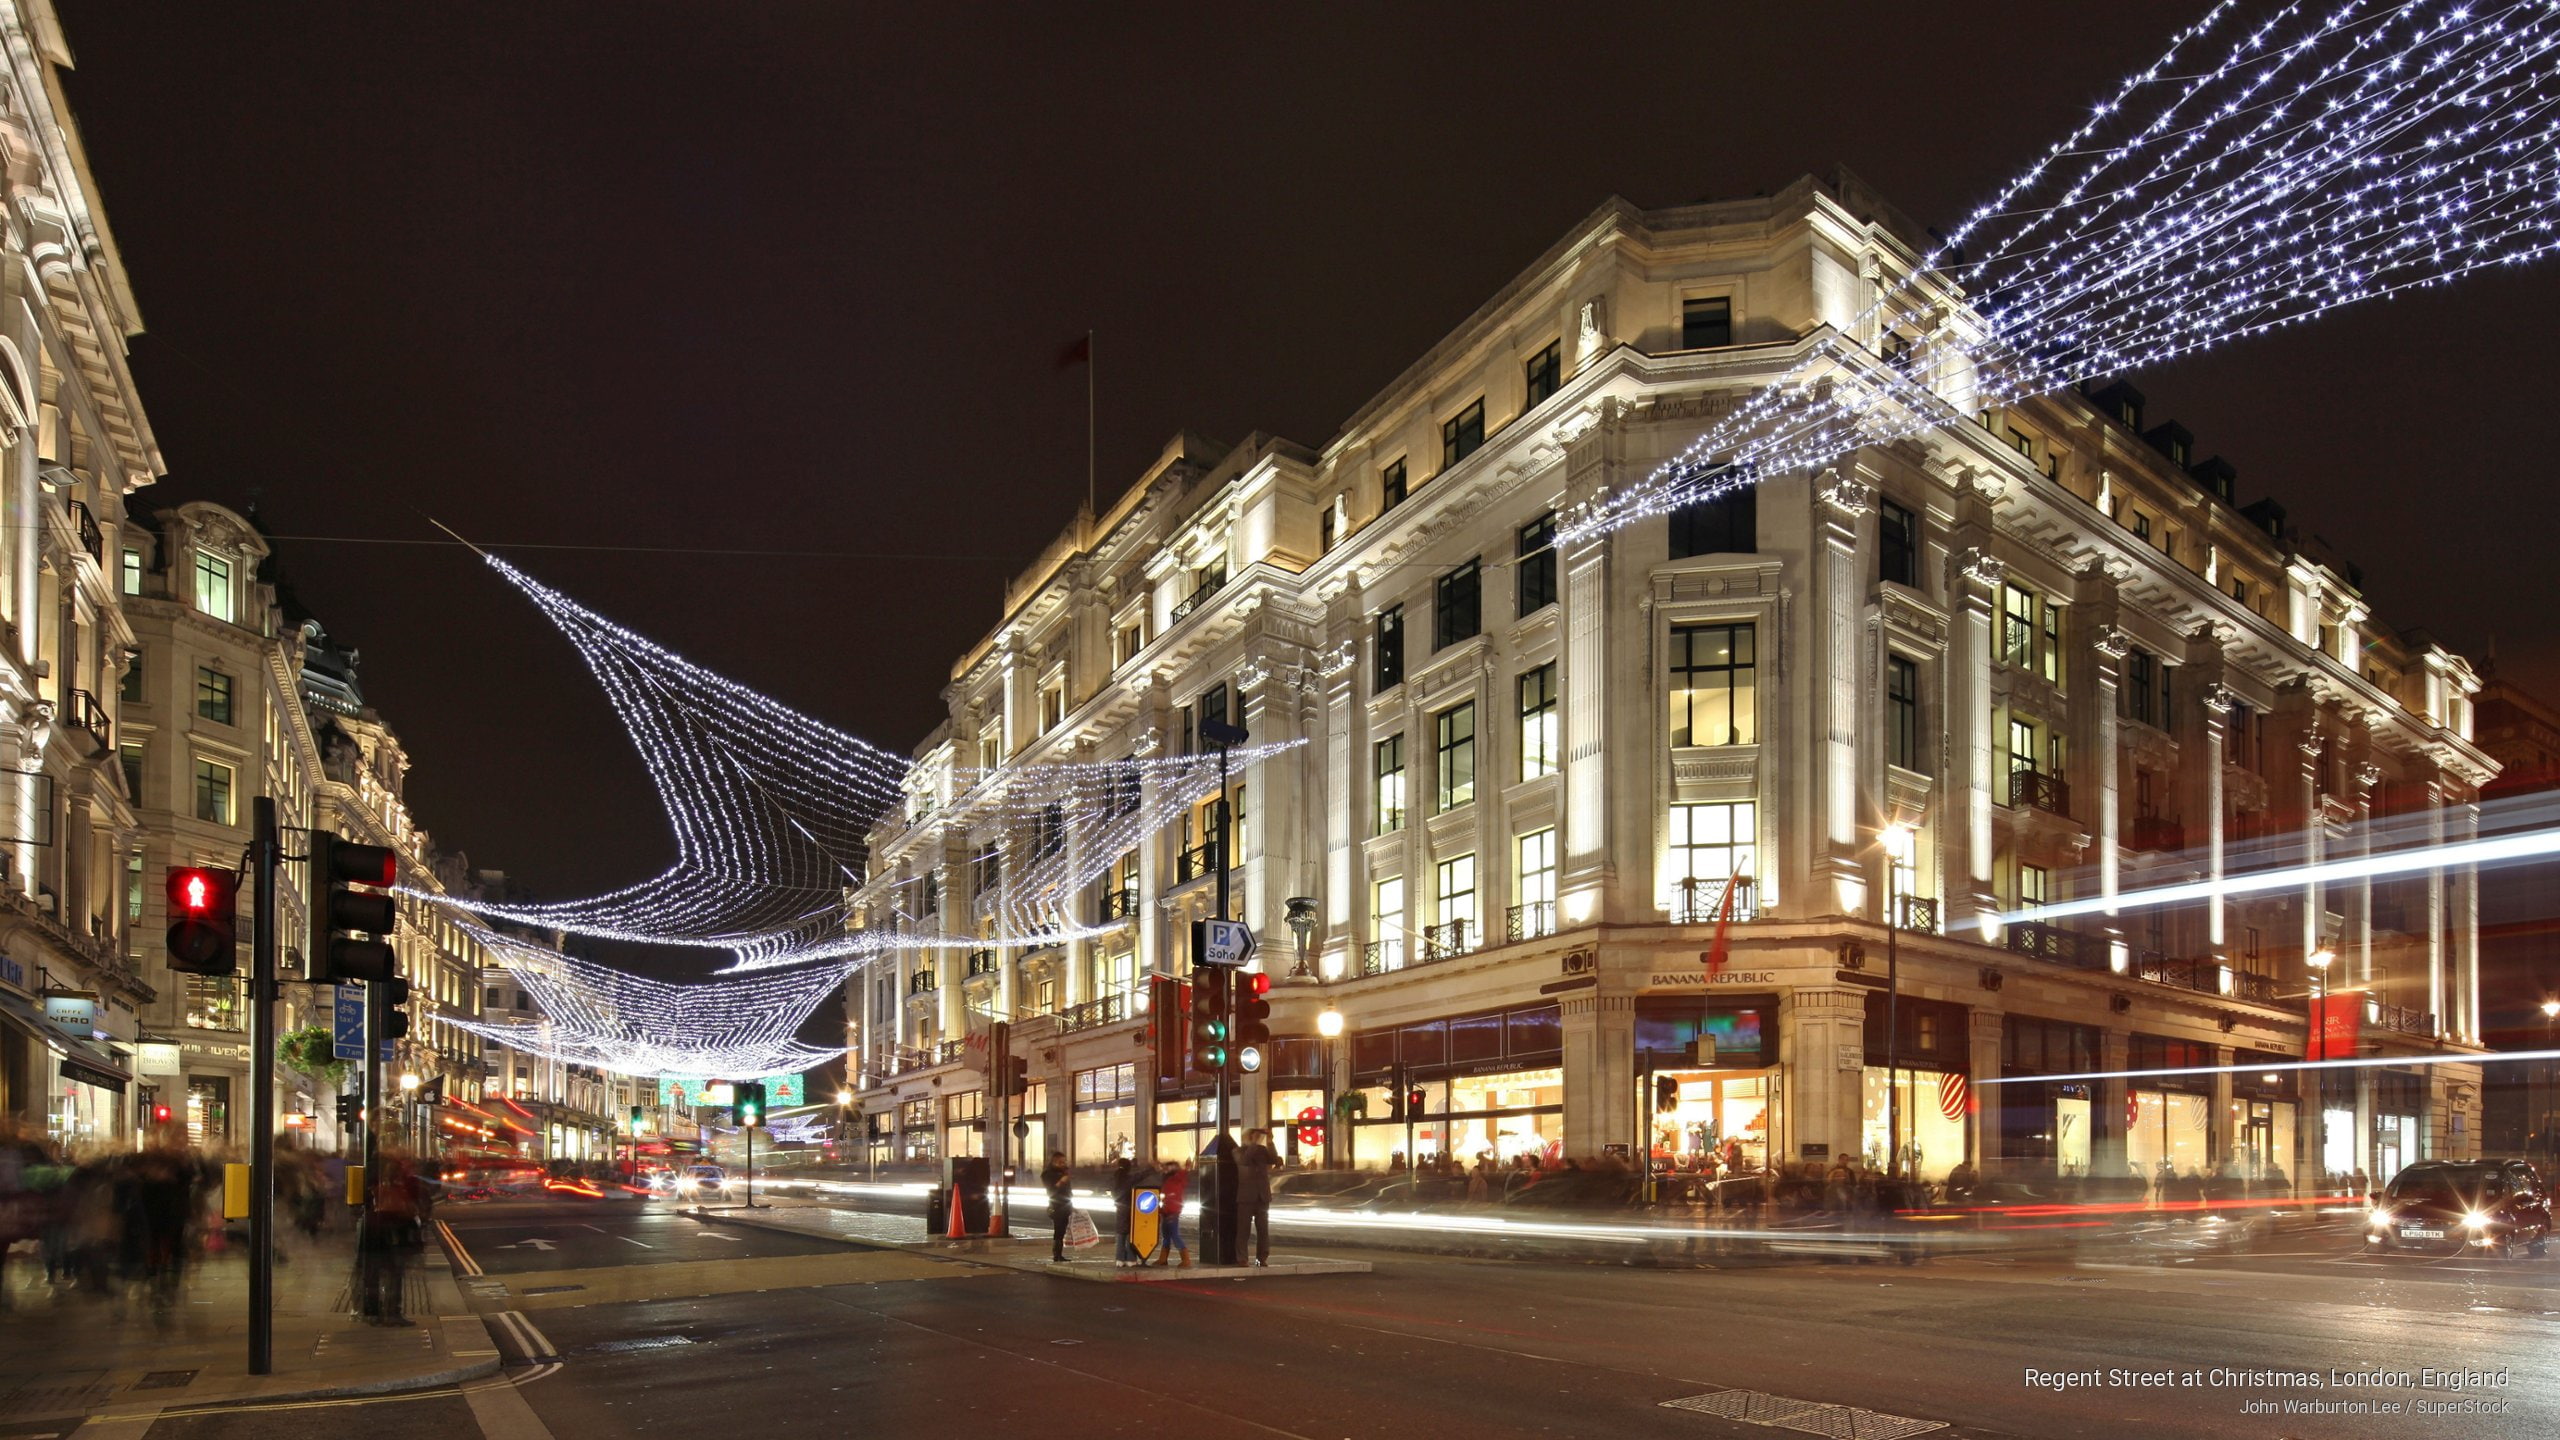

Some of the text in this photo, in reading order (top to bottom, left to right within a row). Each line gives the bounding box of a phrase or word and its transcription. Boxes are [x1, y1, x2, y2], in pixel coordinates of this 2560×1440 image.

[1208, 948, 1236, 961] Soho
[1651, 972, 1775, 986] BANANA REPUBLIC
[49, 1015, 89, 1025] NERO
[339, 1016, 354, 1024] taxi
[142, 1057, 176, 1065] BROWN
[1473, 1062, 1524, 1073] BANANA REPUBLIC
